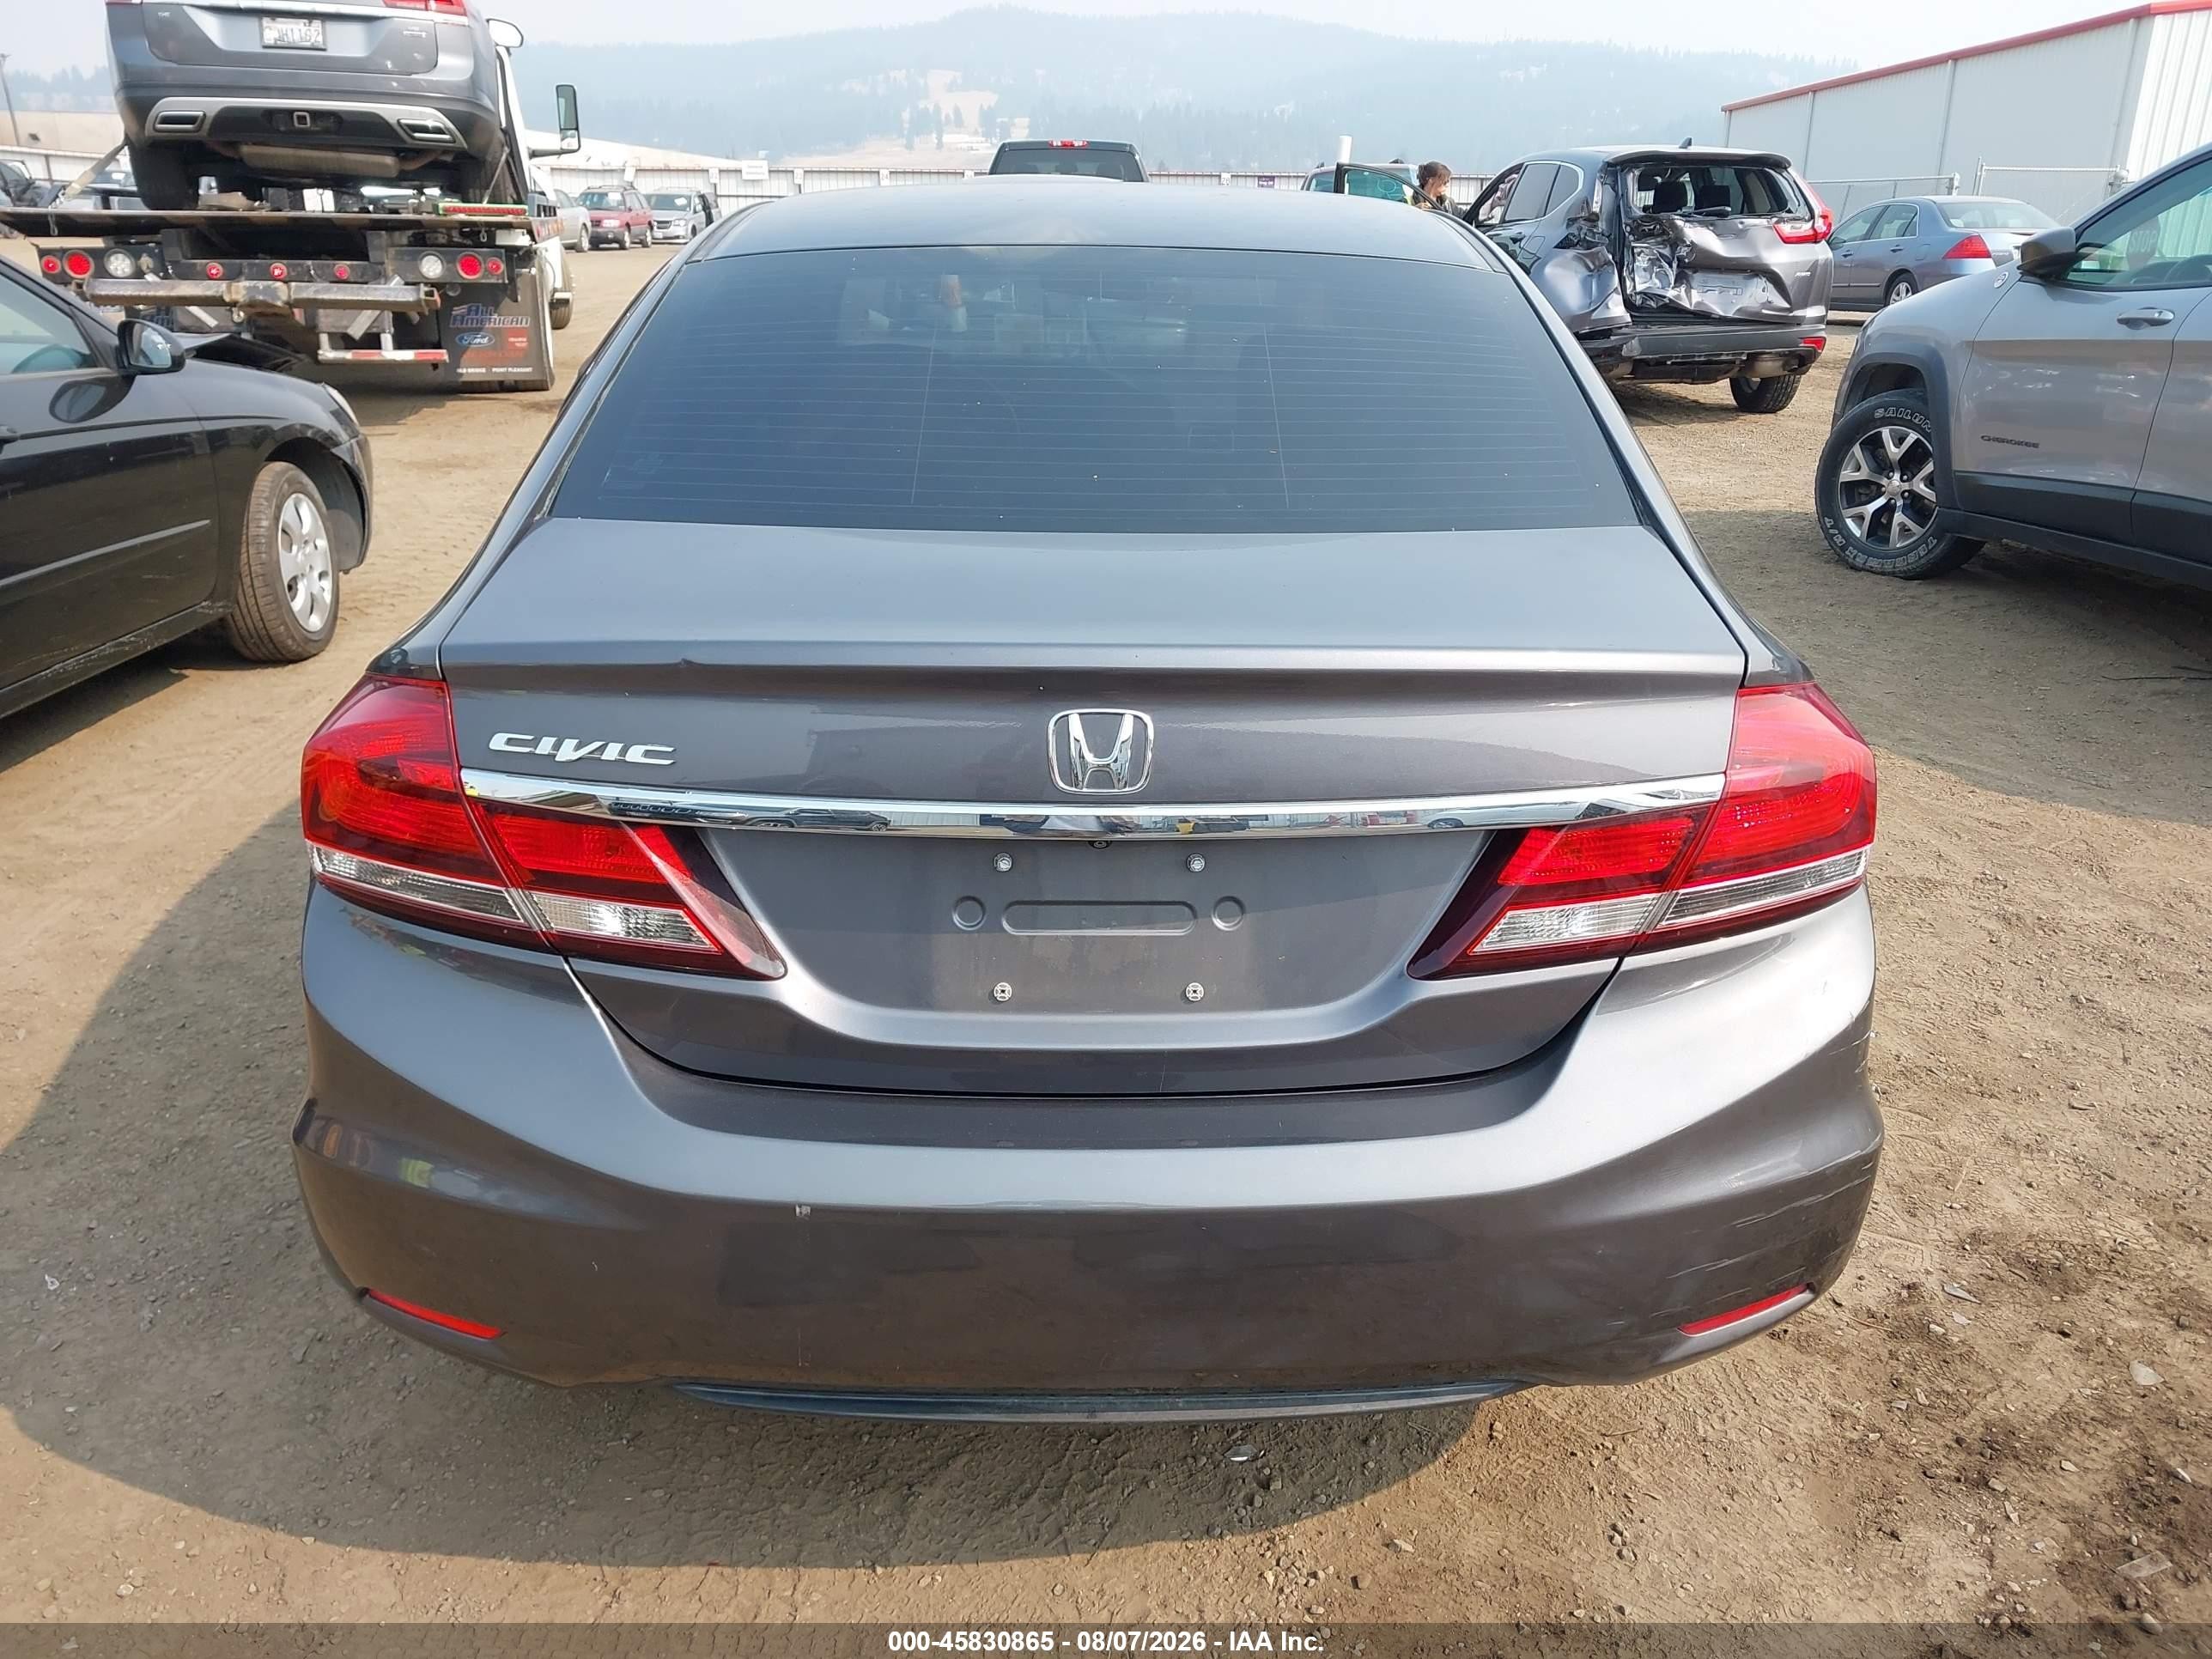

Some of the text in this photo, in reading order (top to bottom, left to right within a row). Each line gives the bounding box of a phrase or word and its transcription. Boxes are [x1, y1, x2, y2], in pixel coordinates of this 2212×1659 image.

[2130, 228, 2159, 253] STOP
[1980, 434, 2040, 449] CHEROKEE
[489, 732, 676, 766] CIVIC
